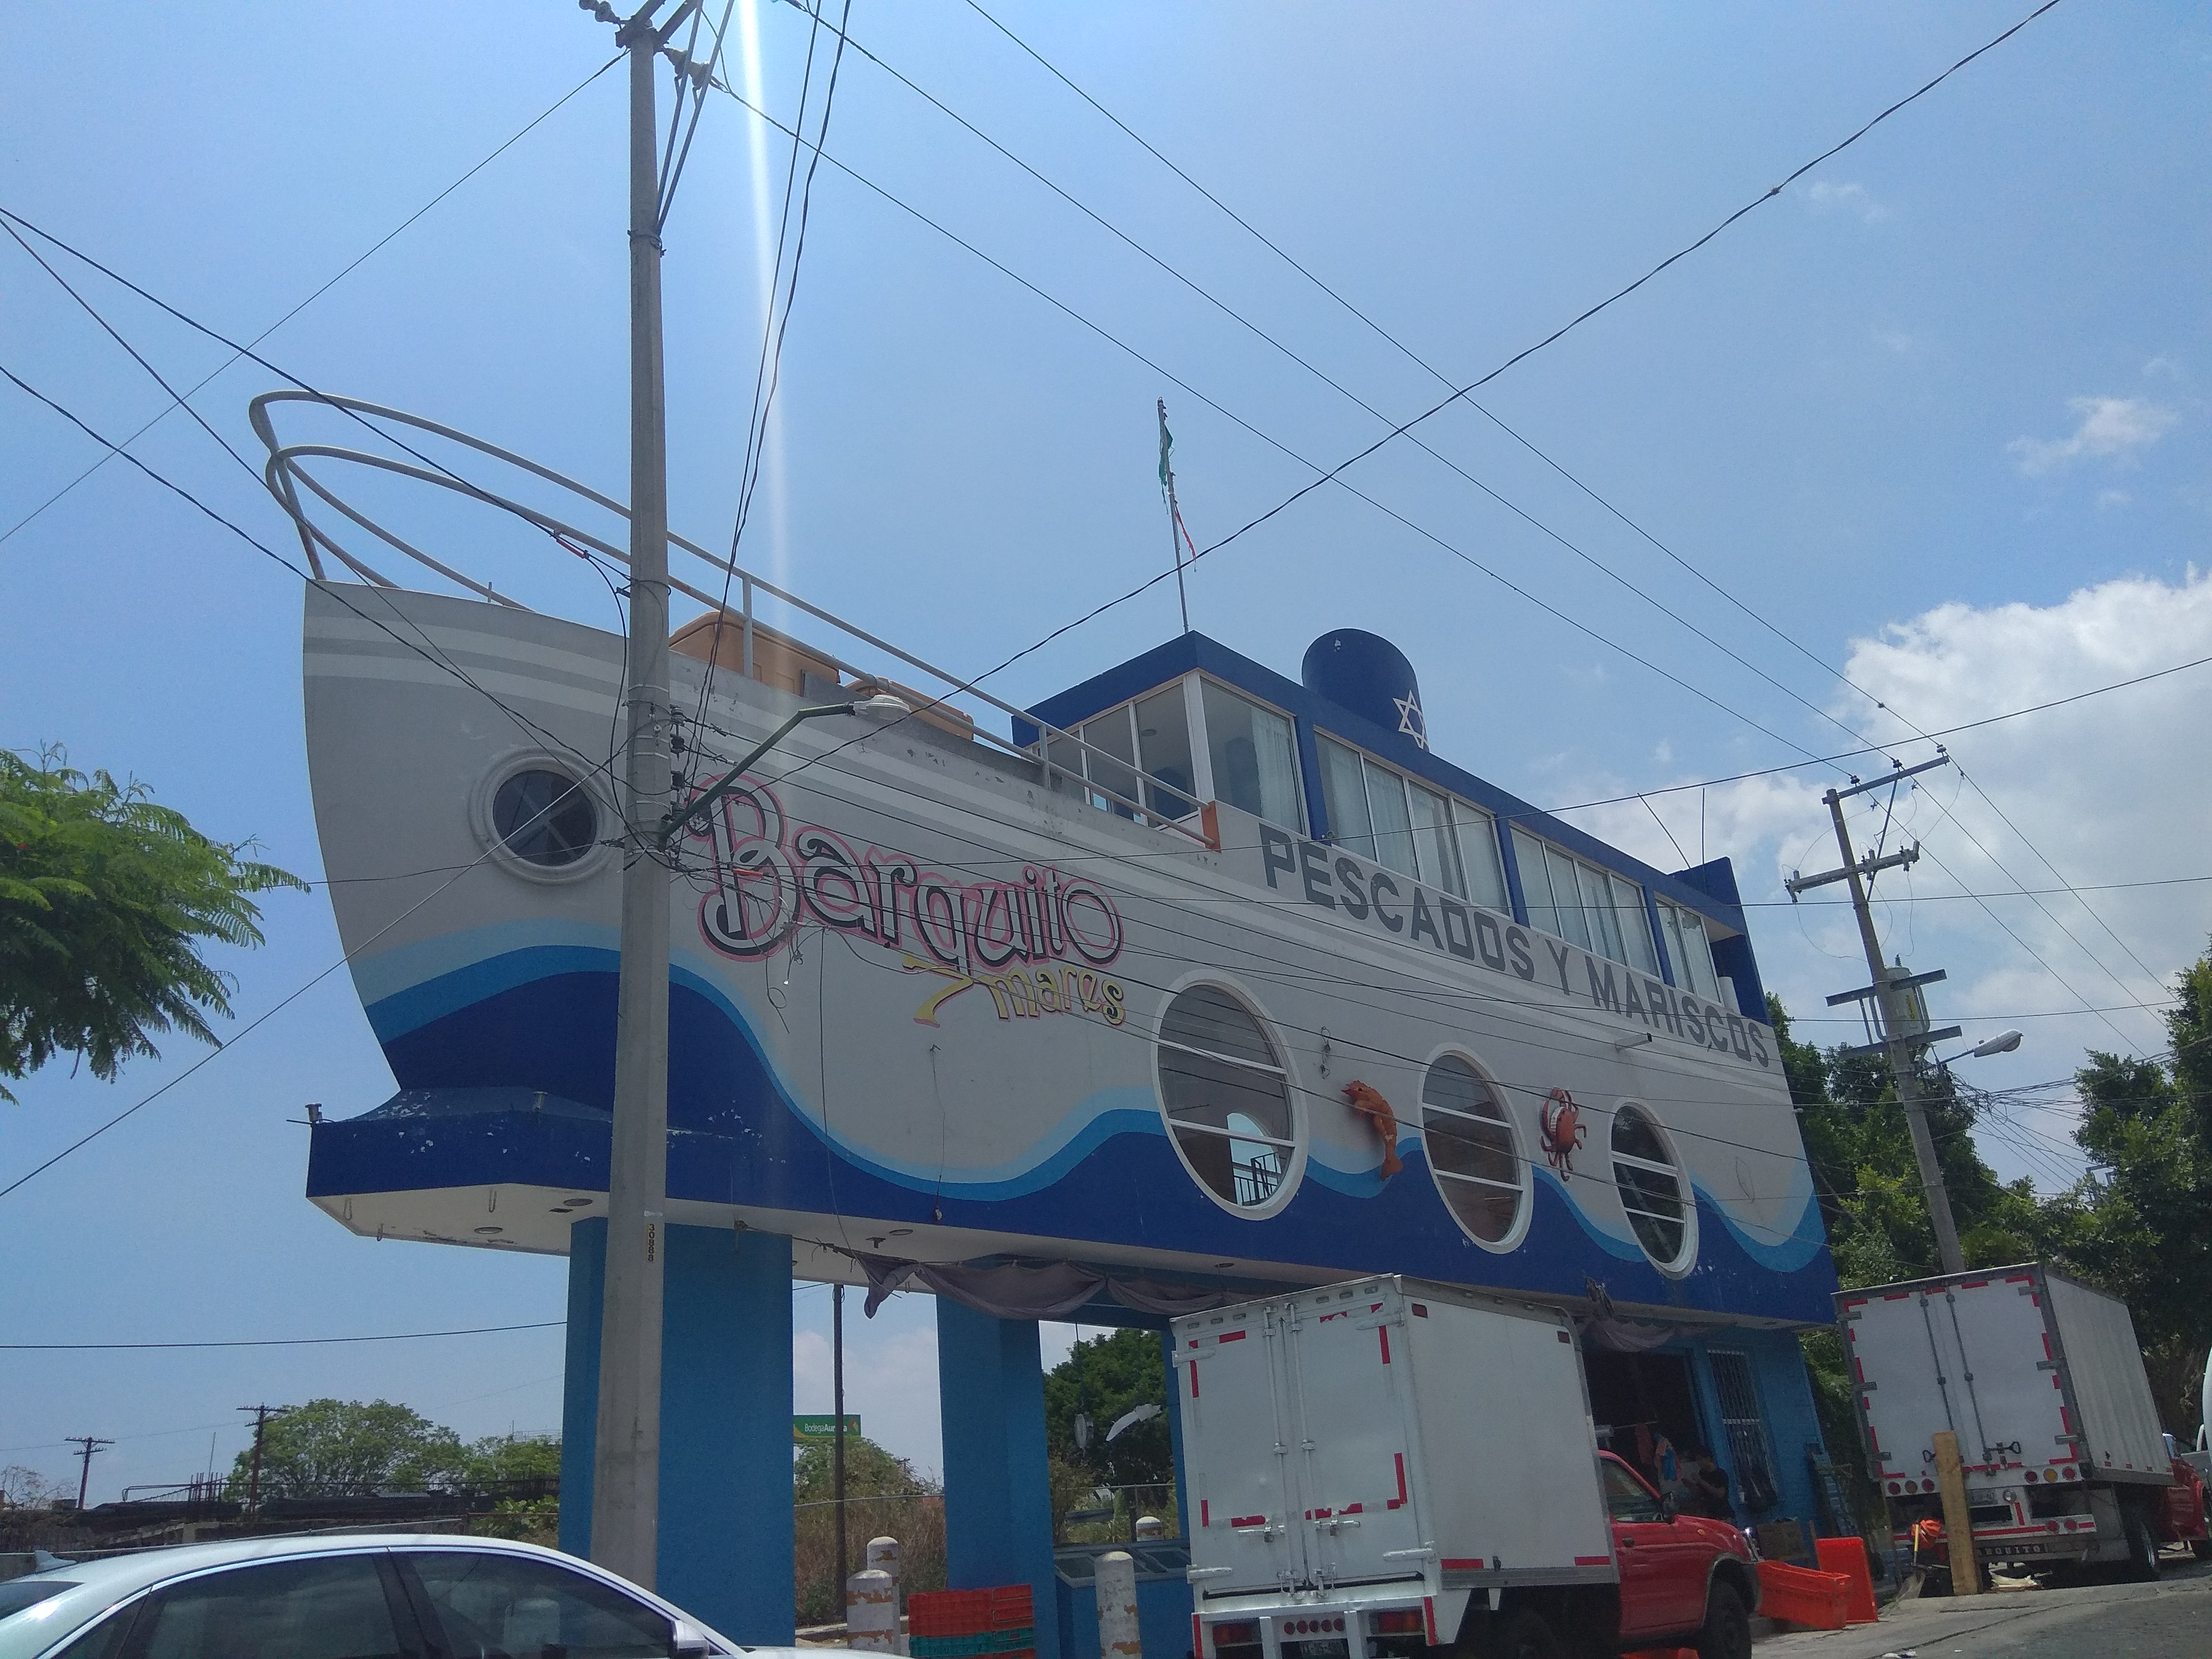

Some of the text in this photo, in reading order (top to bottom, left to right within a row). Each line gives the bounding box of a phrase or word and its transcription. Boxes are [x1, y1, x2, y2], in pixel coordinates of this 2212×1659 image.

[684, 773, 1124, 976] Barquito
[1258, 822, 1770, 1068] PESCADOS Y MARISCOS
[902, 952, 974, 1028] 7
